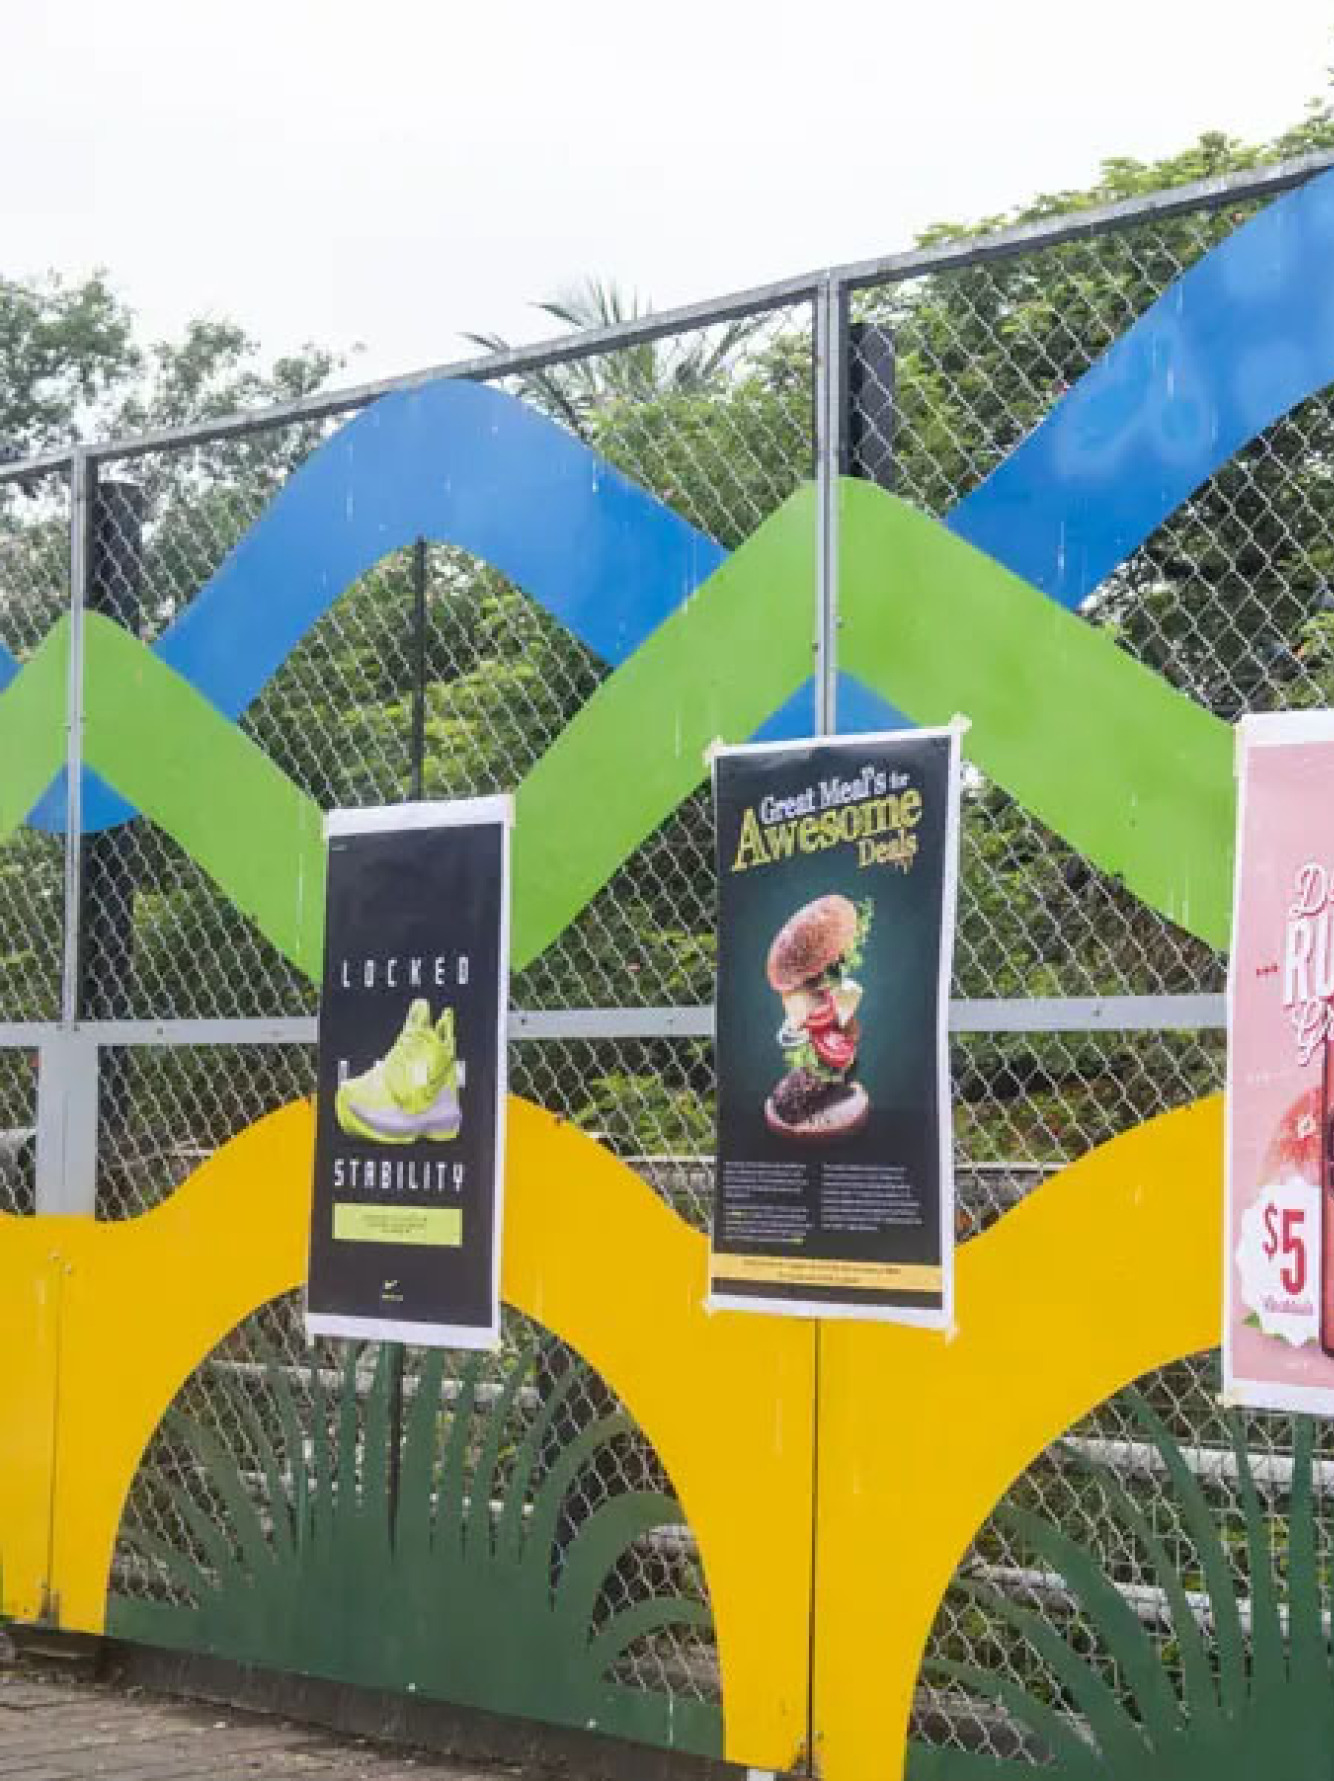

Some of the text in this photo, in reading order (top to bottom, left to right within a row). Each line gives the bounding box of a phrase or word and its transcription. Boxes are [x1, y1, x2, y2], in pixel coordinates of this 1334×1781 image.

[731, 790, 923, 873] Awesome
[342, 957, 469, 987] LOCKED
[334, 1158, 465, 1192] STABILITY
[1262, 1203, 1306, 1296] $5
